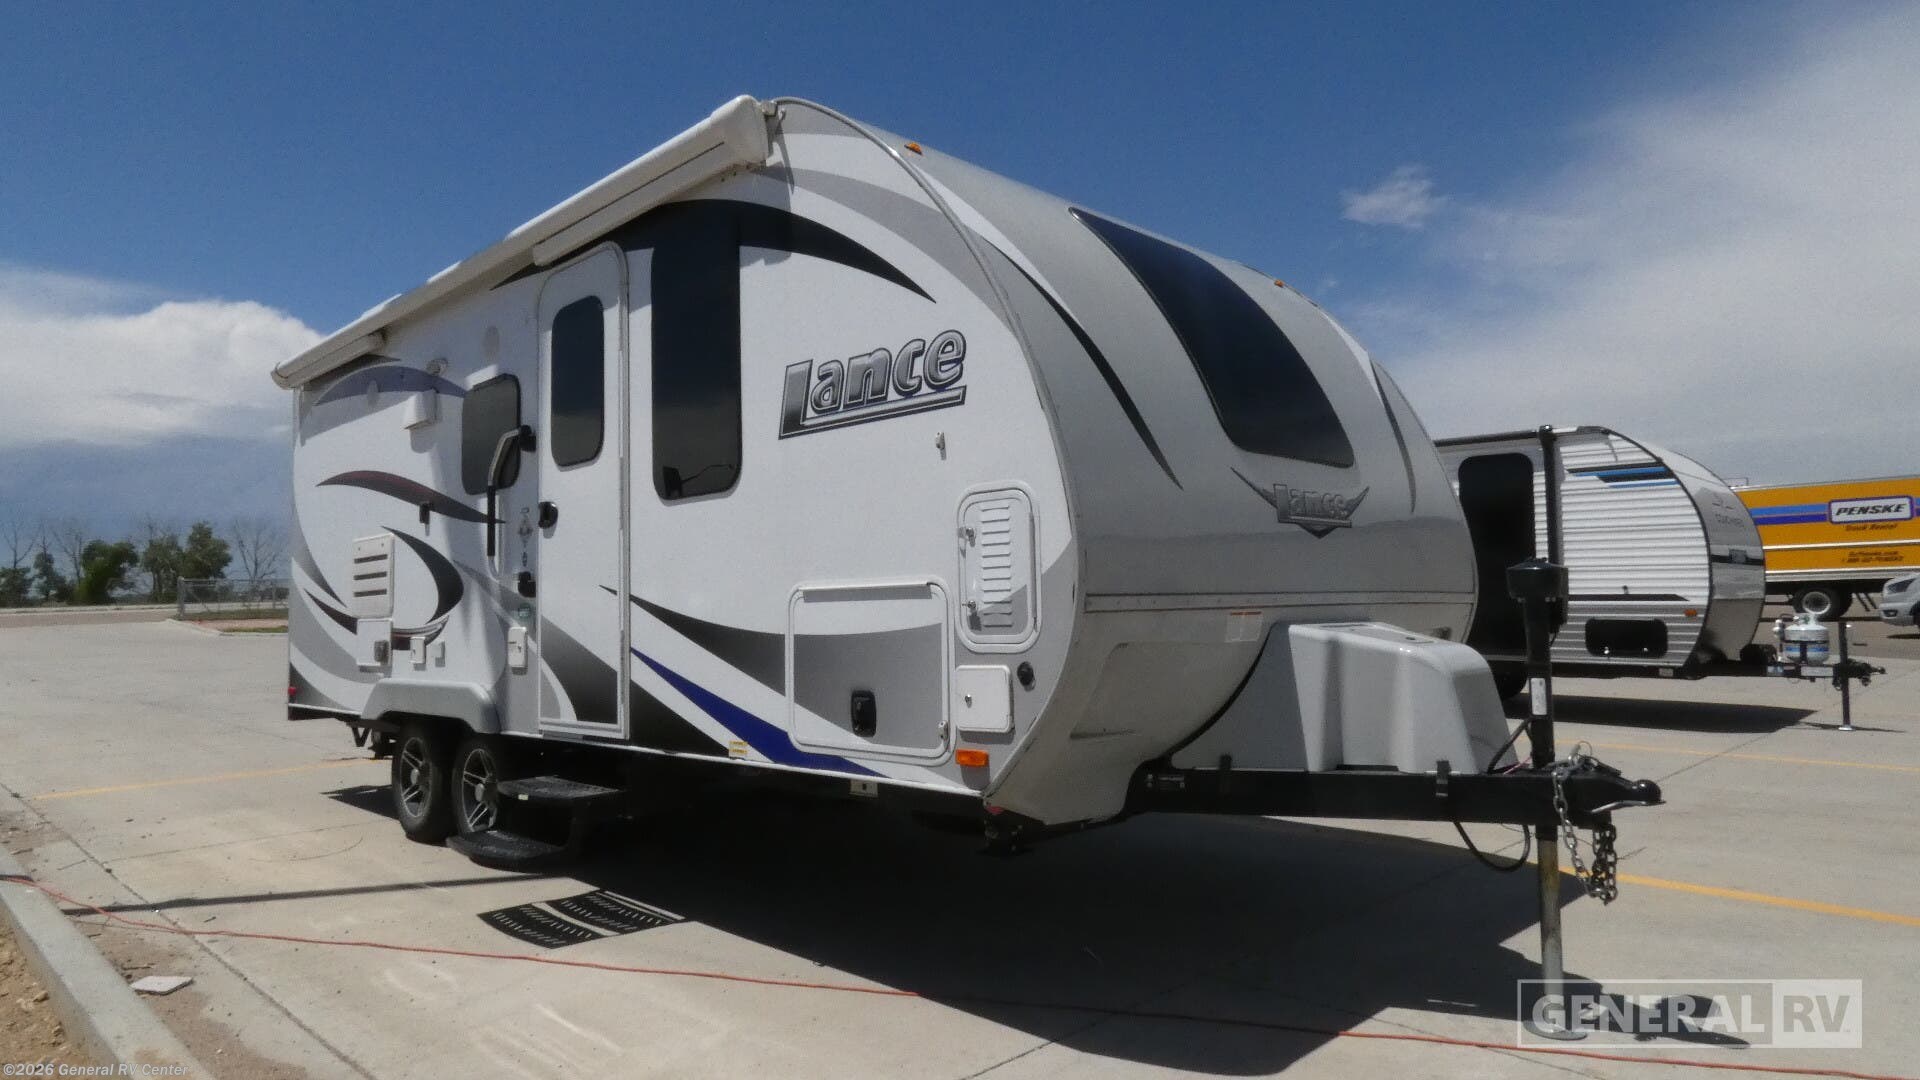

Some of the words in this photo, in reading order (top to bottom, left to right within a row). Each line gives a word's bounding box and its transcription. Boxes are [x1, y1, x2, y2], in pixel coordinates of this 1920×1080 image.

[778, 329, 967, 440] Lance
[1273, 483, 1352, 528] Lance
[1835, 503, 1907, 516] PENSKE
